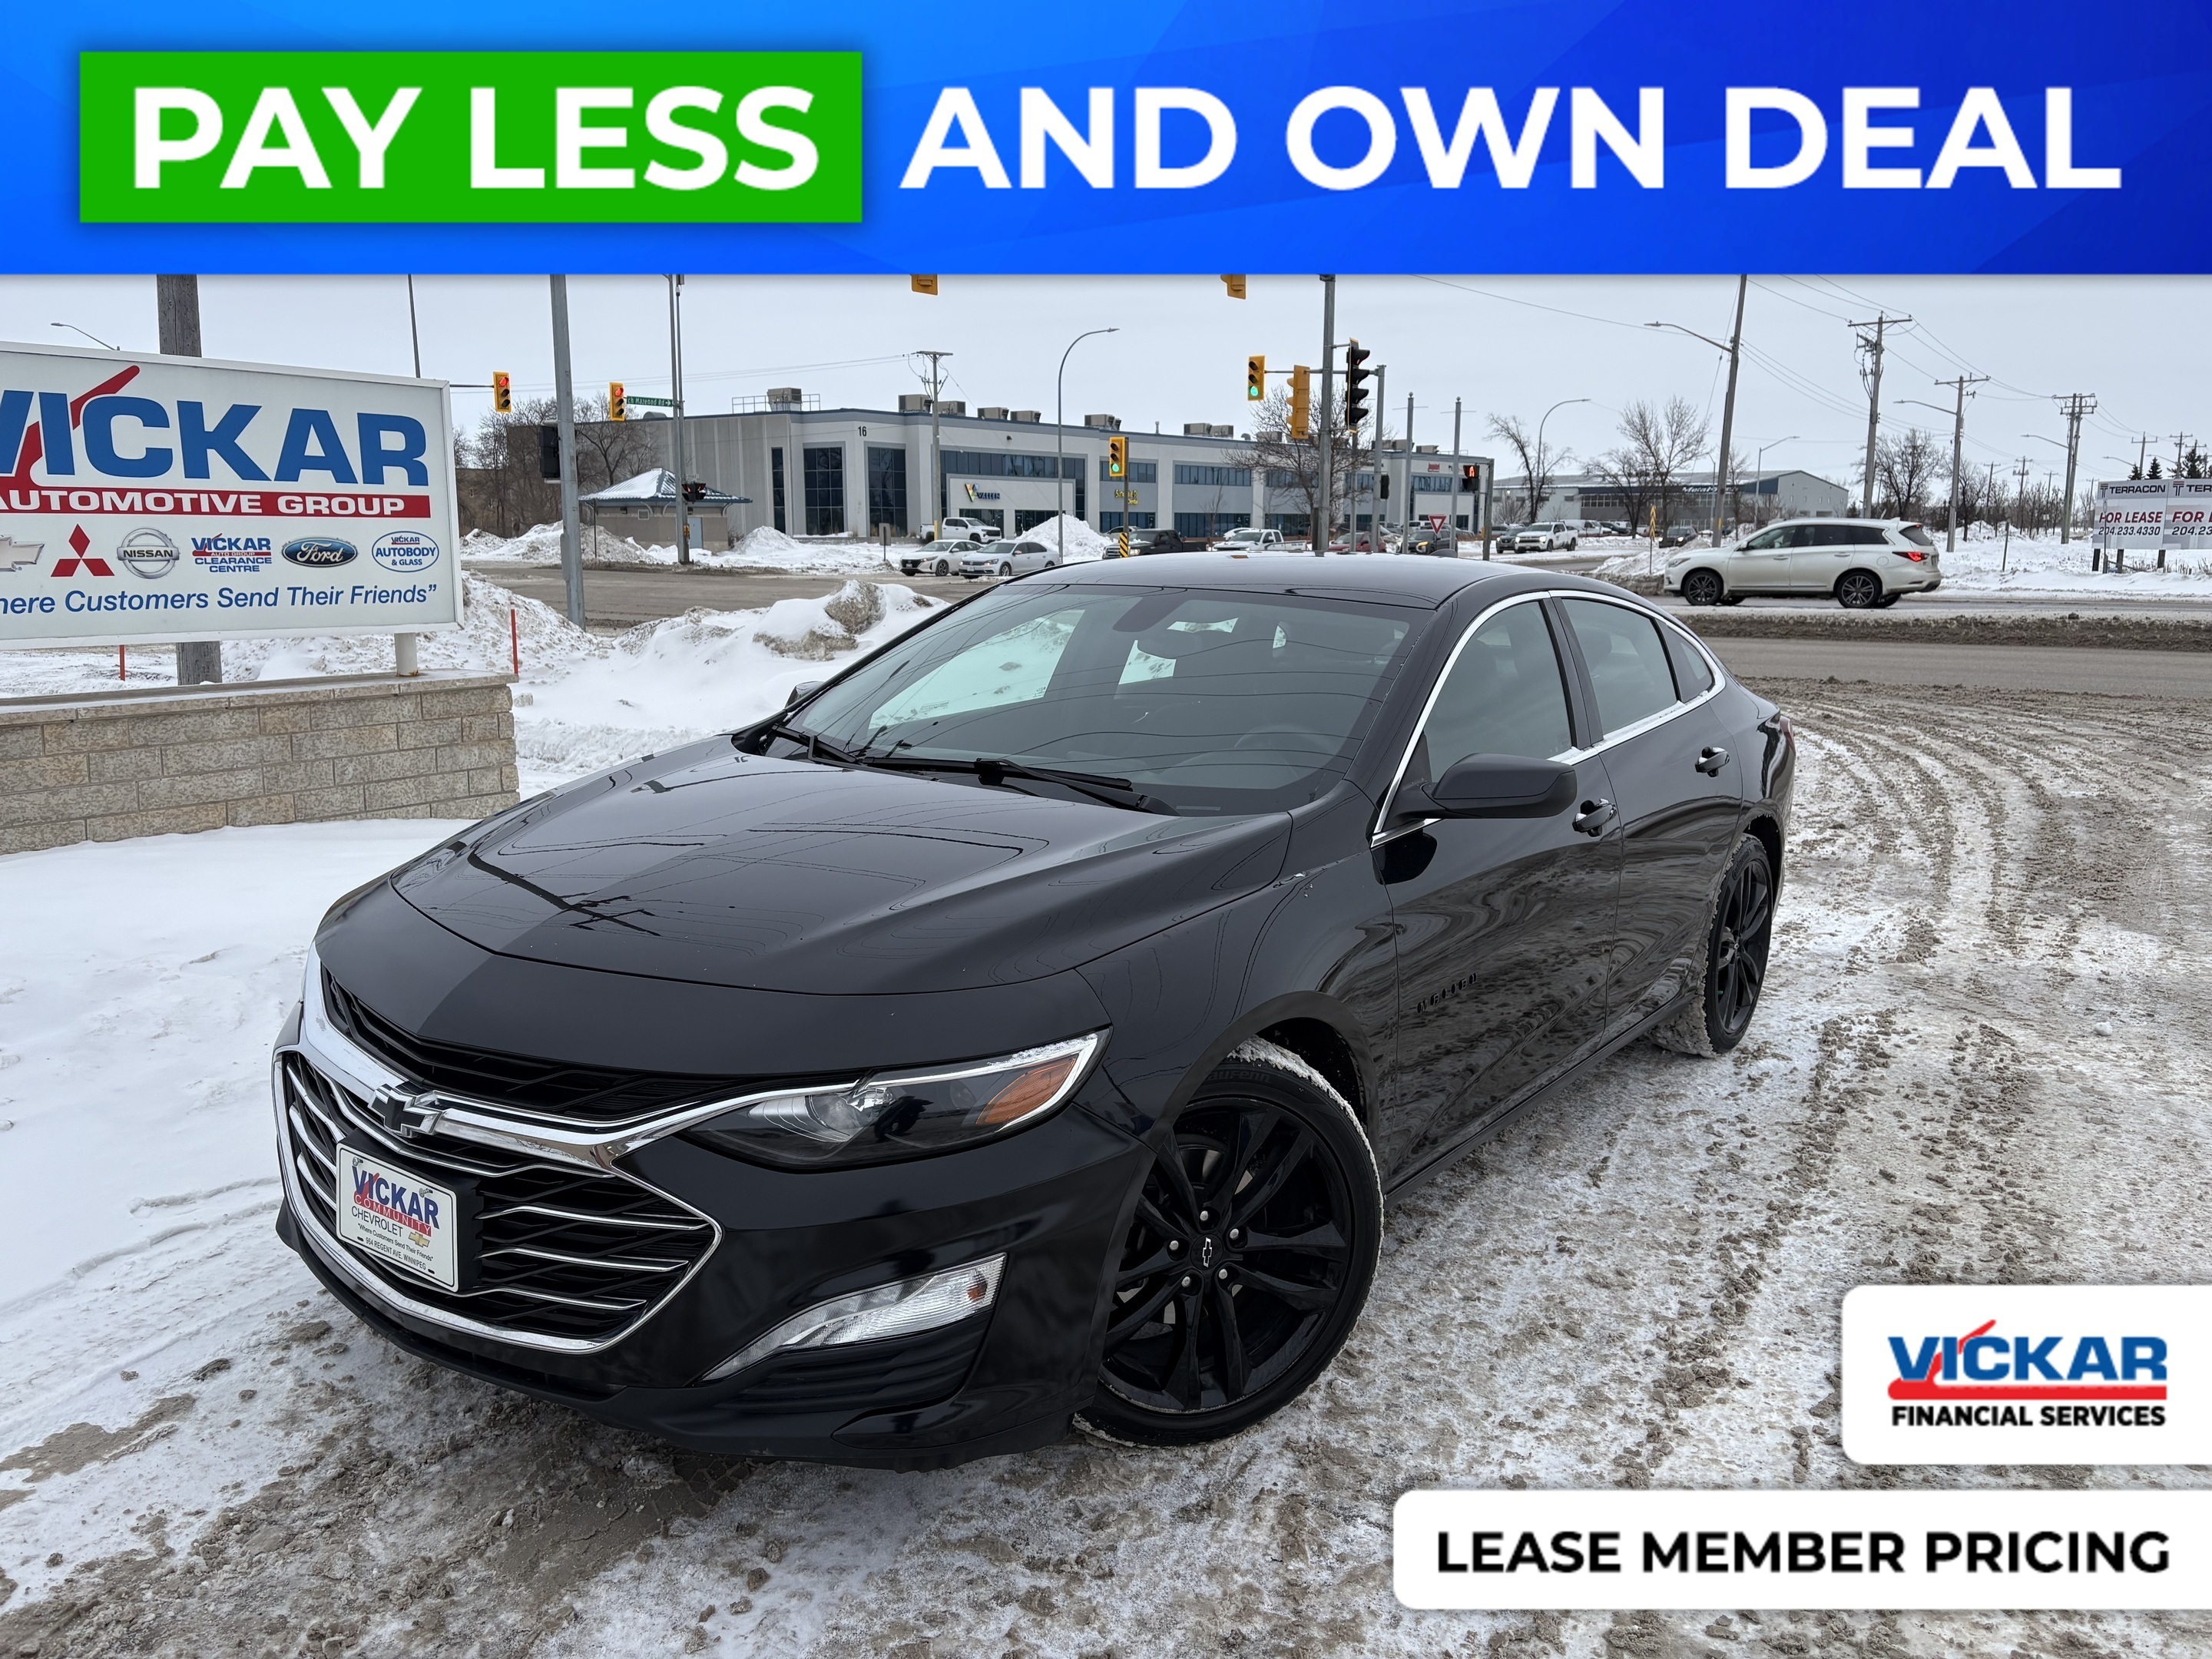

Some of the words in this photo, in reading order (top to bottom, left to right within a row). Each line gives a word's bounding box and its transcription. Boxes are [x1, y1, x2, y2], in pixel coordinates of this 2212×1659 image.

[858, 426, 866, 436] 16
[2109, 485, 2166, 494] TERRACON
[277, 495, 405, 515] GROUP
[2124, 512, 2163, 523] LEASE
[2172, 512, 2204, 523] FOR
[2098, 526, 2161, 535] 204.233.4330
[191, 537, 271, 551] VICKAR
[296, 541, 344, 562] Ford
[376, 548, 436, 557] AUTOBODY
[65, 591, 209, 612] Customers
[217, 587, 279, 608] Send
[287, 586, 343, 605] Their
[352, 1165, 440, 1230] VICKAR
[352, 1206, 403, 1237] CHEVROLET
[355, 1194, 432, 1236] COMMUNITY
[373, 1227, 394, 1244] Customers
[394, 1237, 406, 1250] Send
[406, 1243, 416, 1254] Their
[366, 1237, 374, 1247] 964
[374, 1240, 392, 1255] REGENT
[403, 1253, 427, 1270] WINNIPEG
